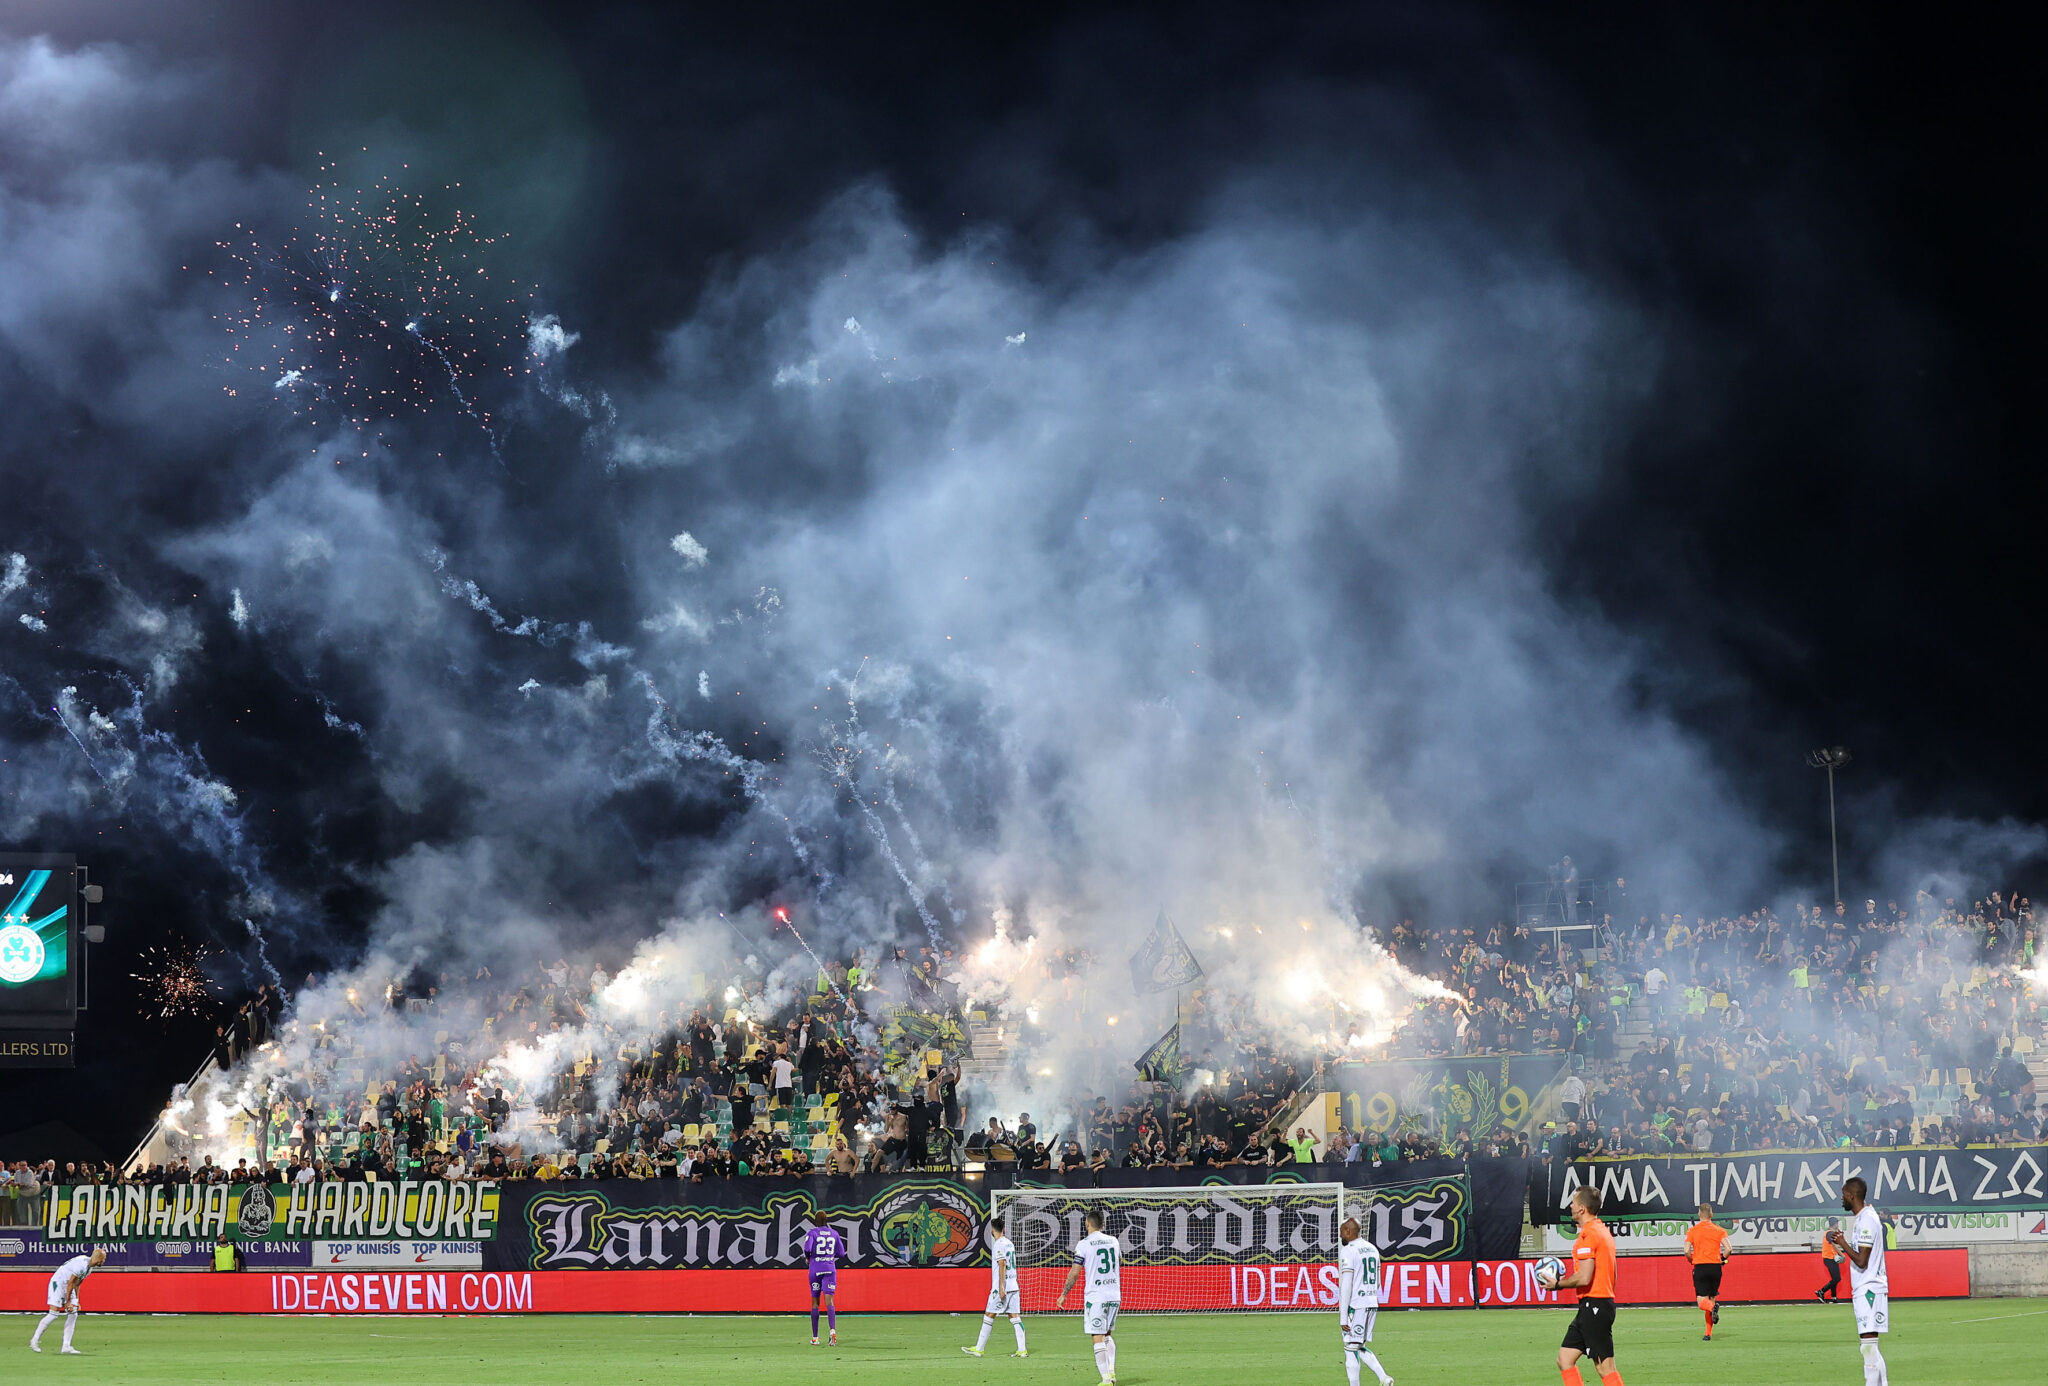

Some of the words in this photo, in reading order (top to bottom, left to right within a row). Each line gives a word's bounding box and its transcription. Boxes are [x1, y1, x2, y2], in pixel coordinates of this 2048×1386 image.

[43, 1043, 68, 1056] LTD
[1347, 1091, 1396, 1133] 19
[48, 1183, 229, 1239] LARNAKA
[287, 1181, 495, 1238] HARDCORE
[537, 1201, 866, 1265] Larnaka
[1901, 1213, 2008, 1235] cytavision
[28, 1241, 88, 1253] HELLENIC
[264, 1241, 300, 1253] BANK
[328, 1243, 353, 1255] TOP
[356, 1242, 400, 1255] KINISIS
[412, 1243, 437, 1254] TOP
[816, 1237, 835, 1254] 23
[1096, 1247, 1115, 1274] 31
[1362, 1257, 1376, 1284] 19
[272, 1273, 532, 1310] IDEASEVEN.COM
